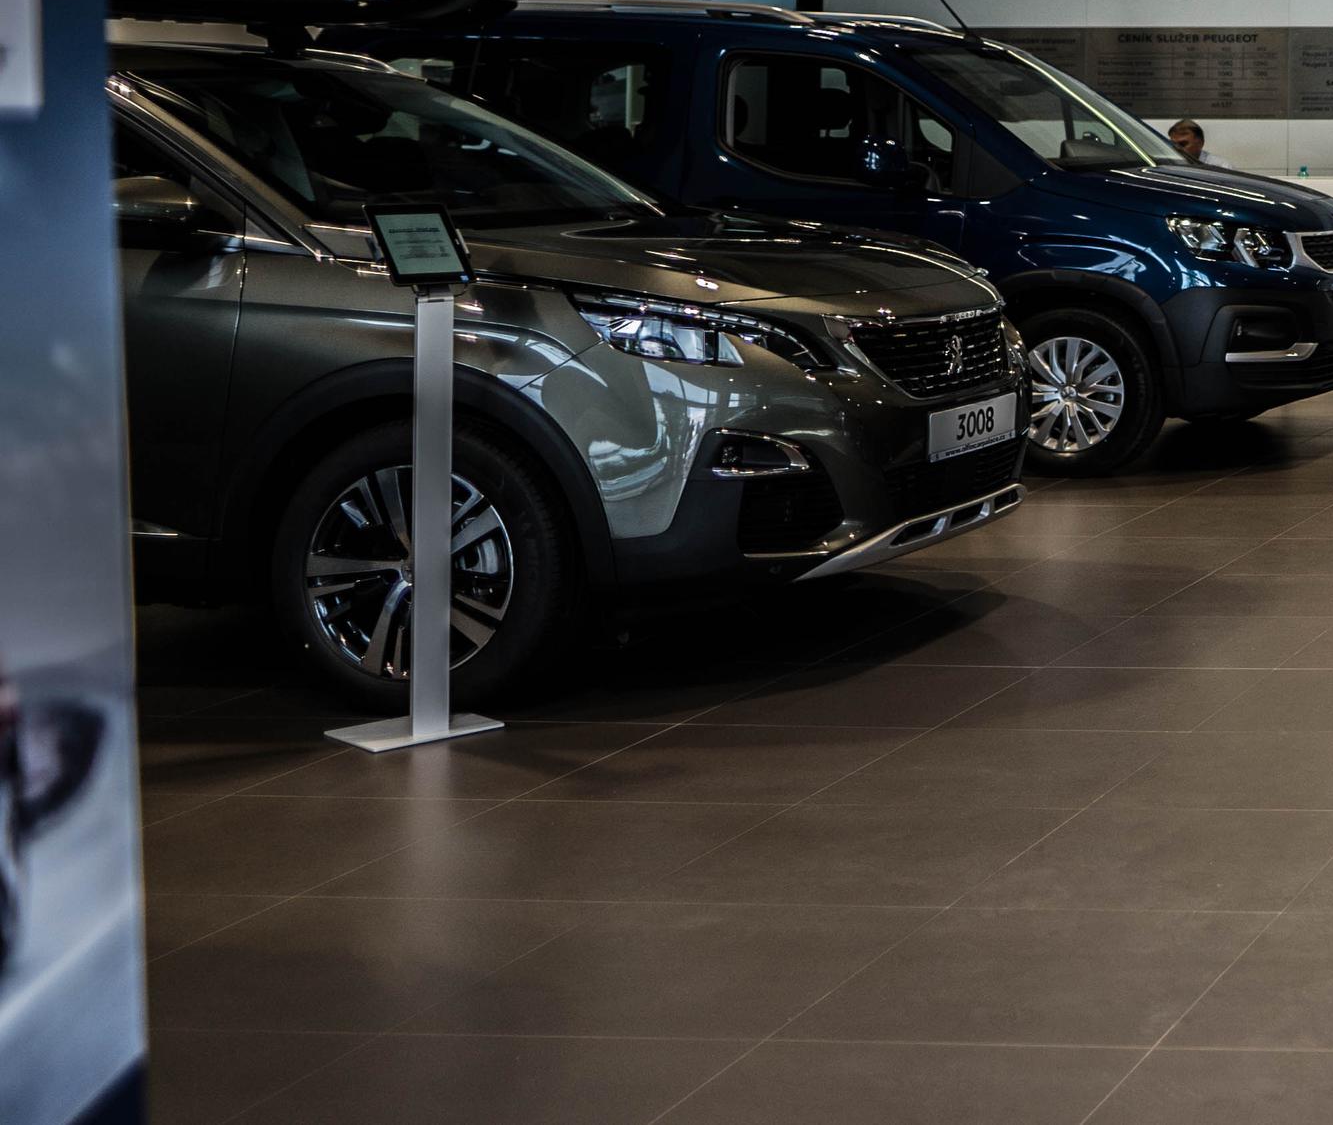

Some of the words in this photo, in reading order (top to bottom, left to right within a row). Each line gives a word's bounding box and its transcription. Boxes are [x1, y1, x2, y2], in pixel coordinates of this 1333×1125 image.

[1157, 32, 1199, 43] SLUŽEB
[1203, 33, 1258, 43] PEUGEOT
[956, 406, 994, 441] 3008
